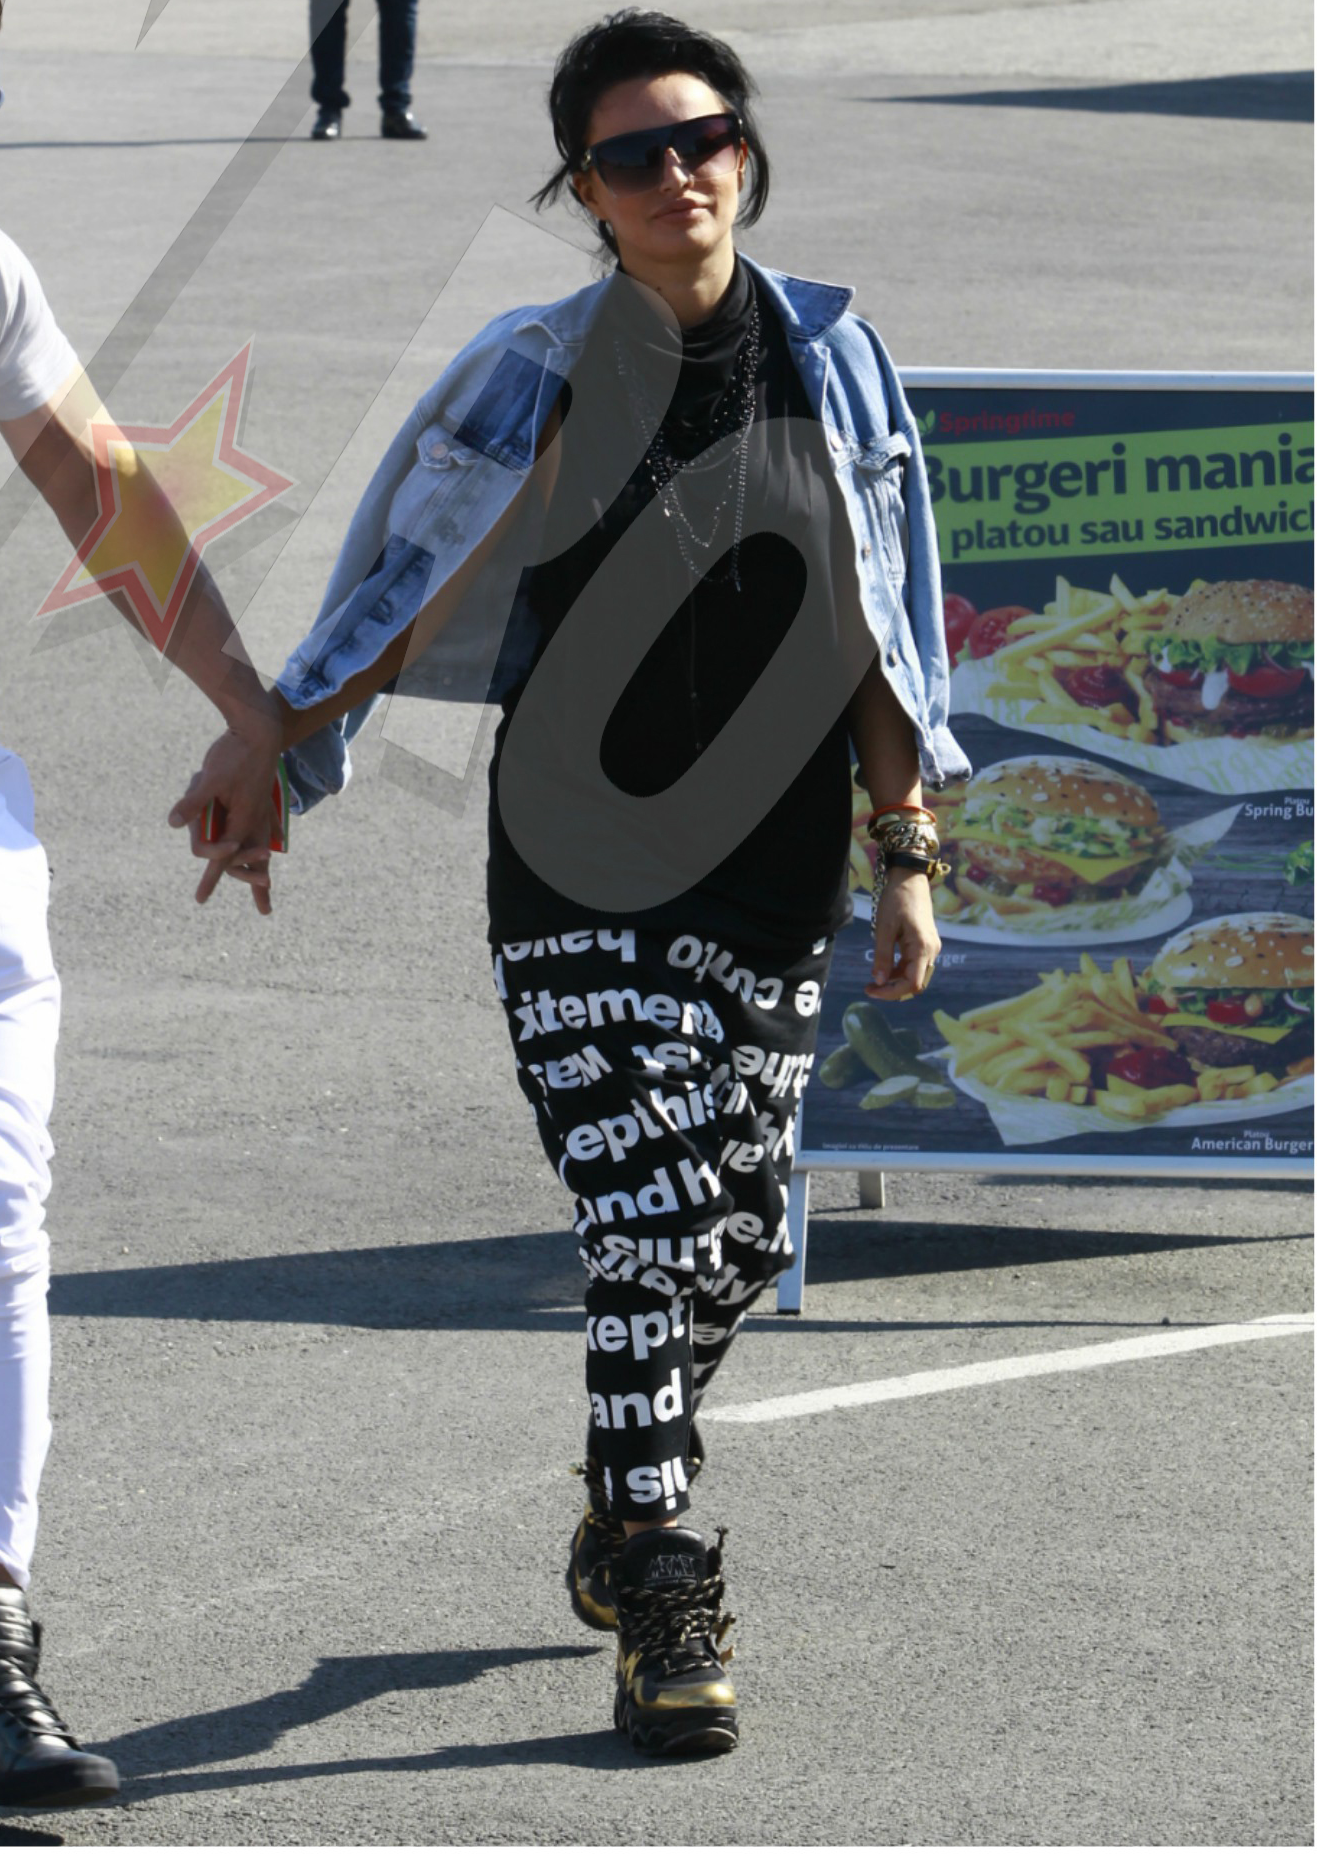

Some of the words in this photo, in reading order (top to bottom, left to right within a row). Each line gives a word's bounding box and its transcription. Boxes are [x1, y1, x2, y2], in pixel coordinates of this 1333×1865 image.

[939, 408, 1076, 436] Springtime
[951, 519, 1070, 560] platou
[1080, 517, 1144, 545] sau
[1154, 499, 1315, 541] sandwic
[1244, 802, 1292, 821] Spring
[564, 1098, 664, 1163] ept
[1191, 1136, 1261, 1151] American
[1264, 1136, 1314, 1155] Burger
[590, 1367, 684, 1430] and
